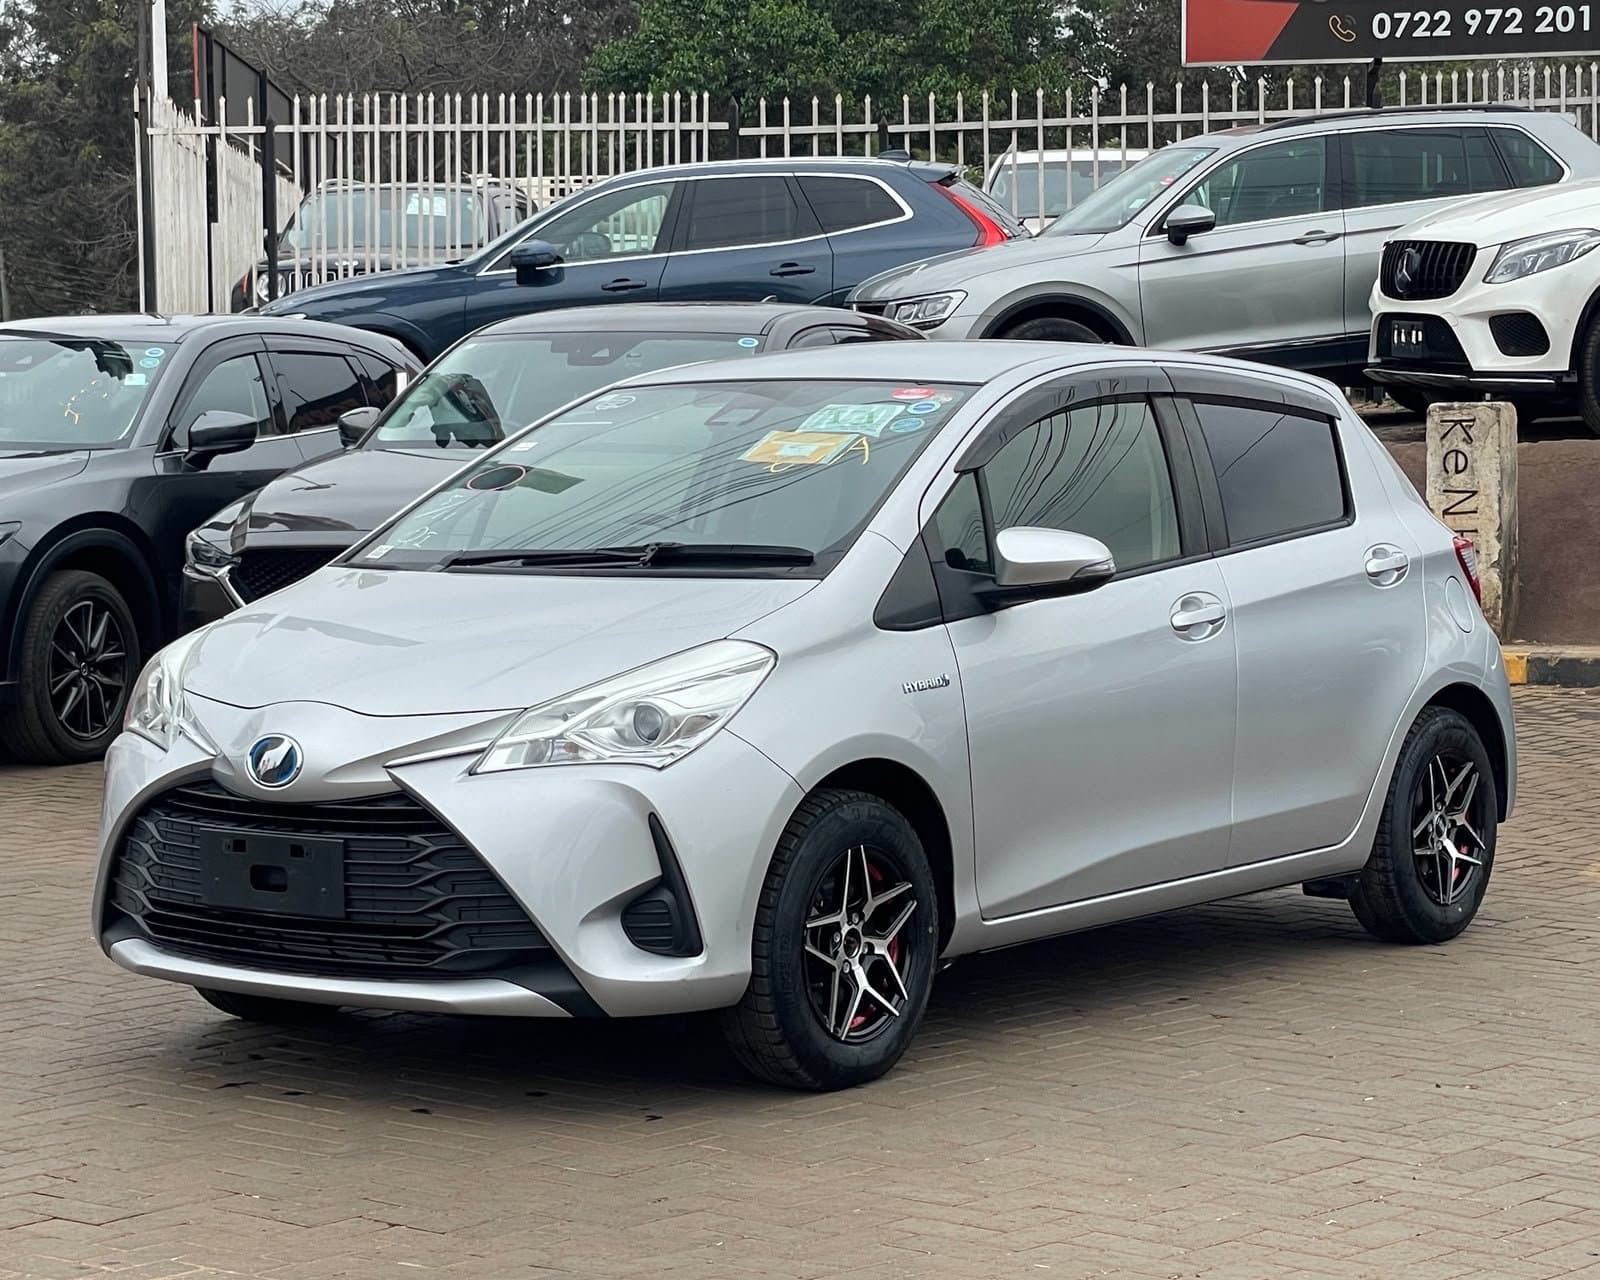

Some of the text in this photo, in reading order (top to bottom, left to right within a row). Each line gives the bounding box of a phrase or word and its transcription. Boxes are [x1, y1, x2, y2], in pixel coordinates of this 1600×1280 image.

[1371, 5, 1591, 40] 0722 972 201
[902, 676, 944, 694] HYBRID
